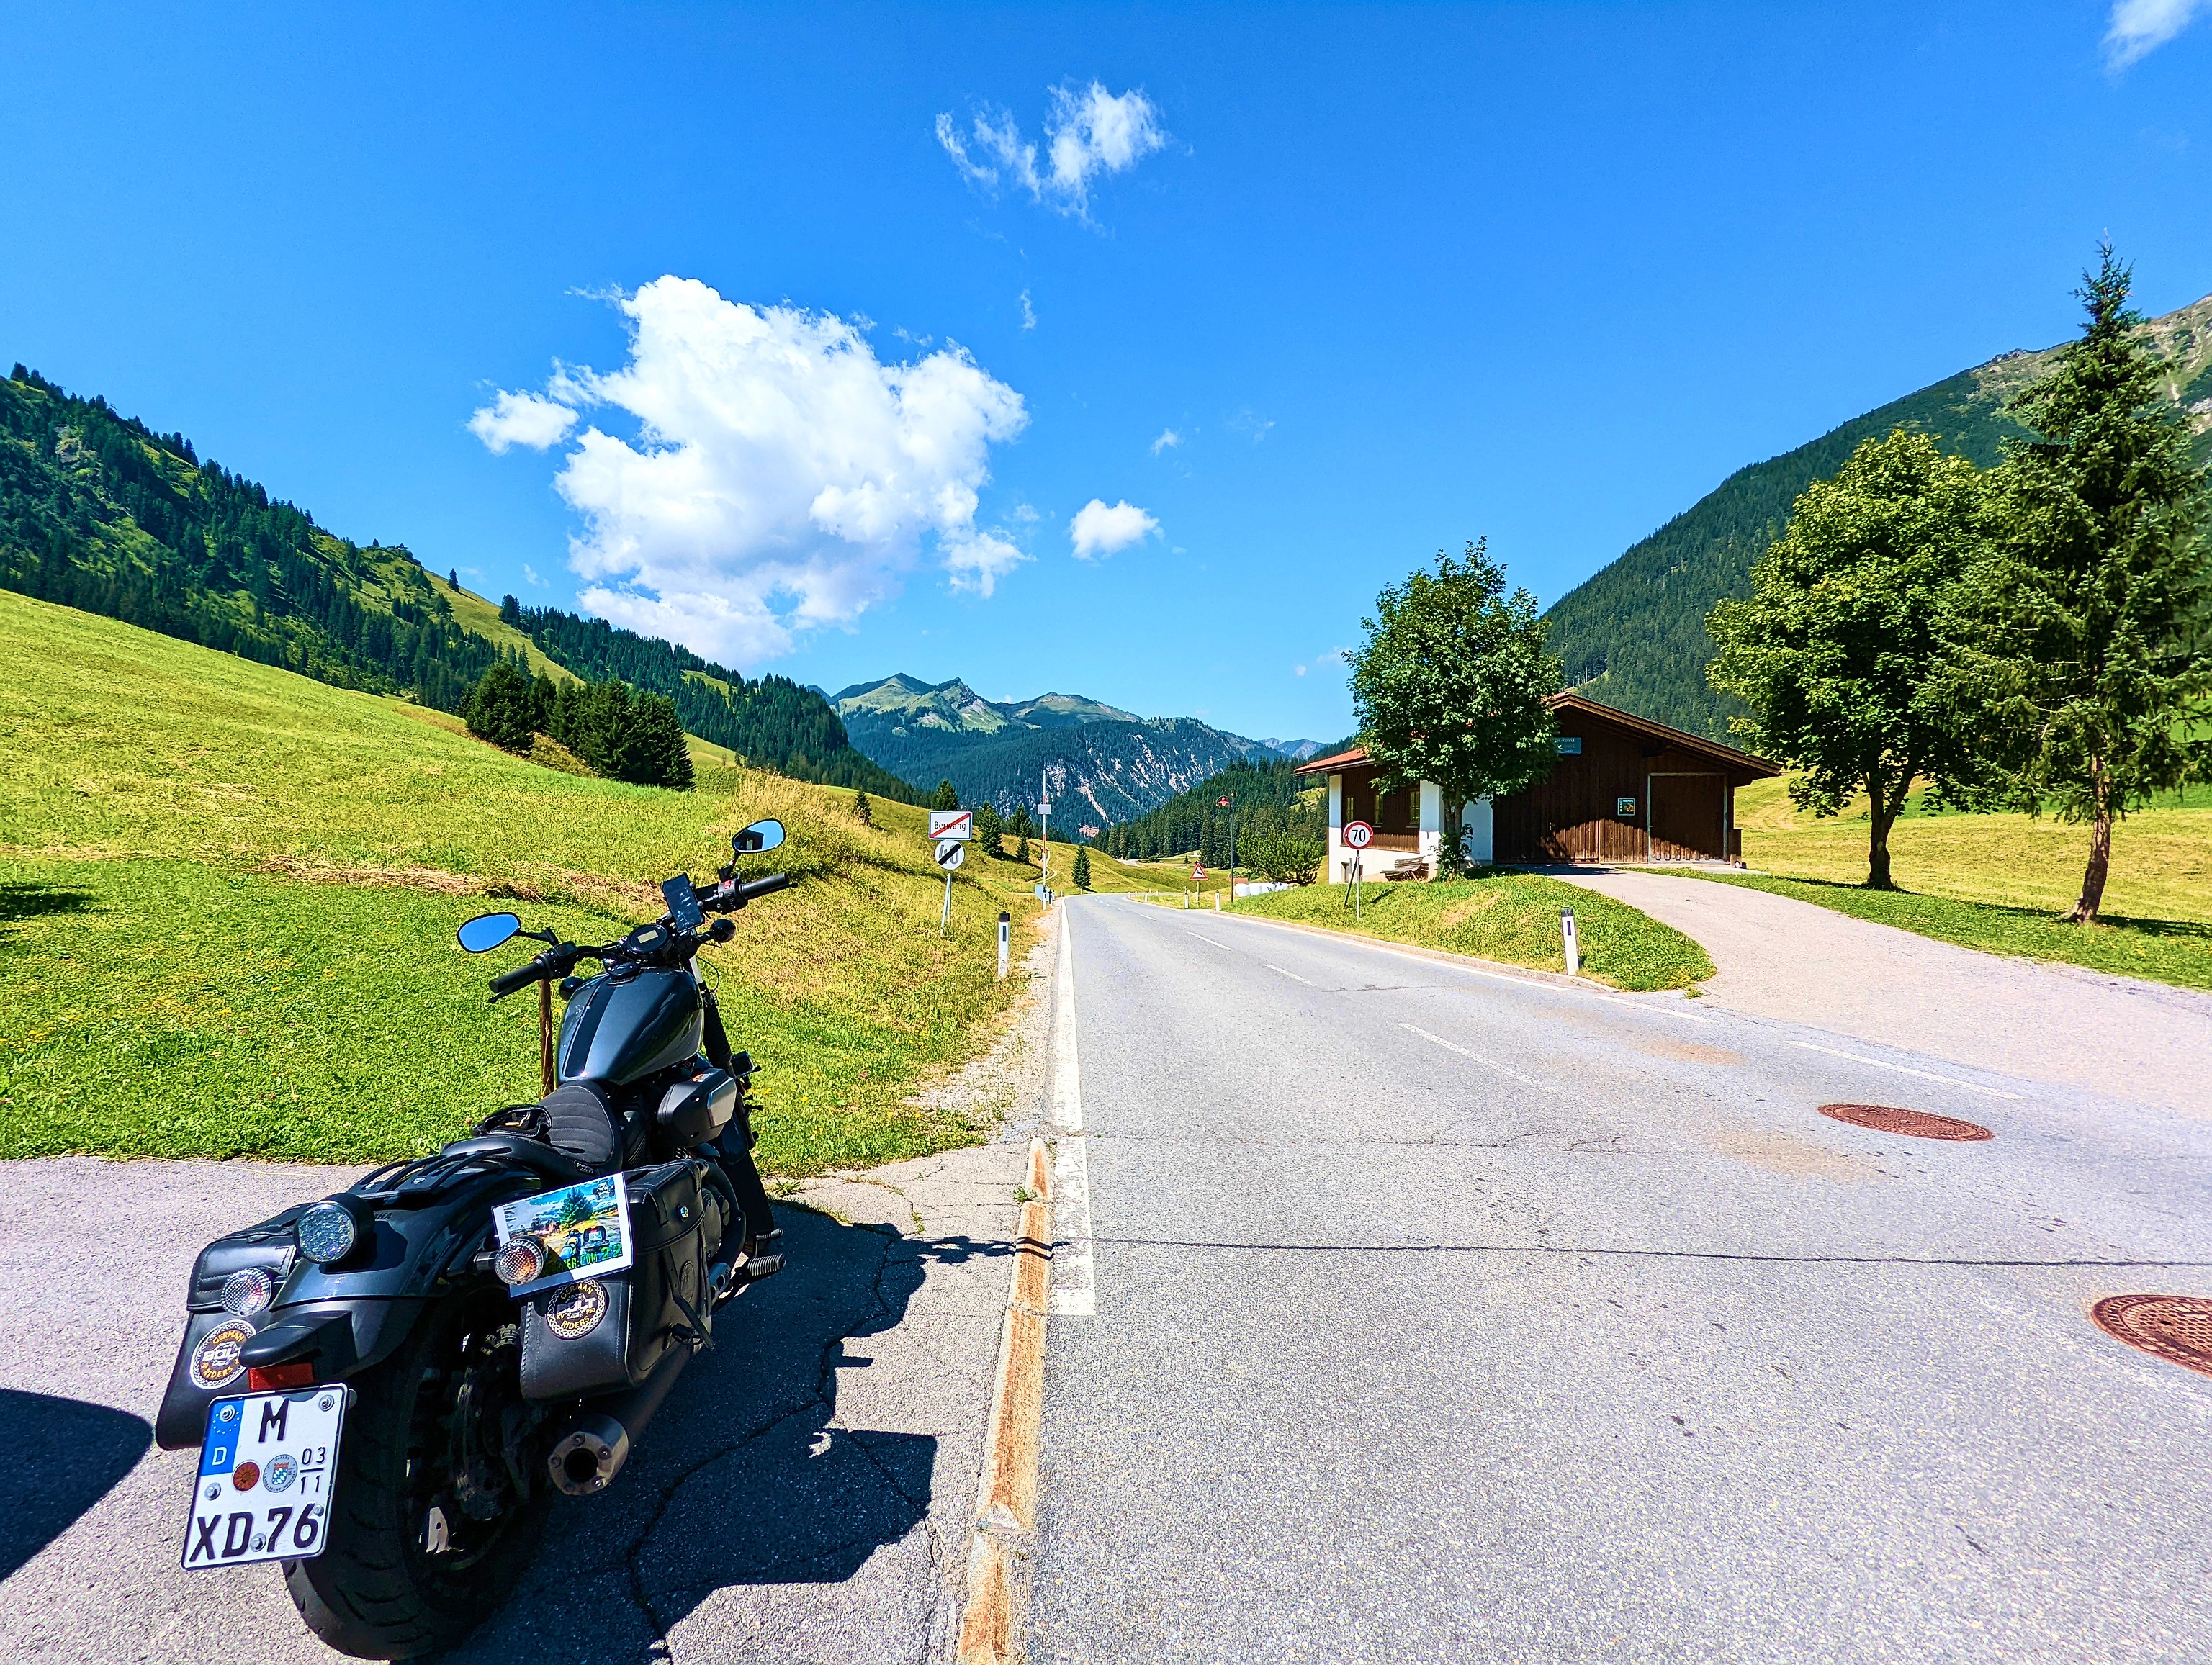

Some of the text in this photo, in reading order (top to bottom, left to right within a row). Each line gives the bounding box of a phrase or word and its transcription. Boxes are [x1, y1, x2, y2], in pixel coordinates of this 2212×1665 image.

[934, 821, 966, 831] Berwang
[1352, 829, 1366, 843] 70
[560, 1283, 594, 1299] GERMAN
[561, 1316, 590, 1330] RIDERS
[212, 1330, 245, 1344] GERMAN
[203, 1366, 233, 1379] RIDERS
[258, 1398, 290, 1443] M
[212, 1447, 228, 1466] D
[302, 1446, 326, 1465] 03
[300, 1475, 321, 1494] 11
[189, 1502, 319, 1562] XD 76
